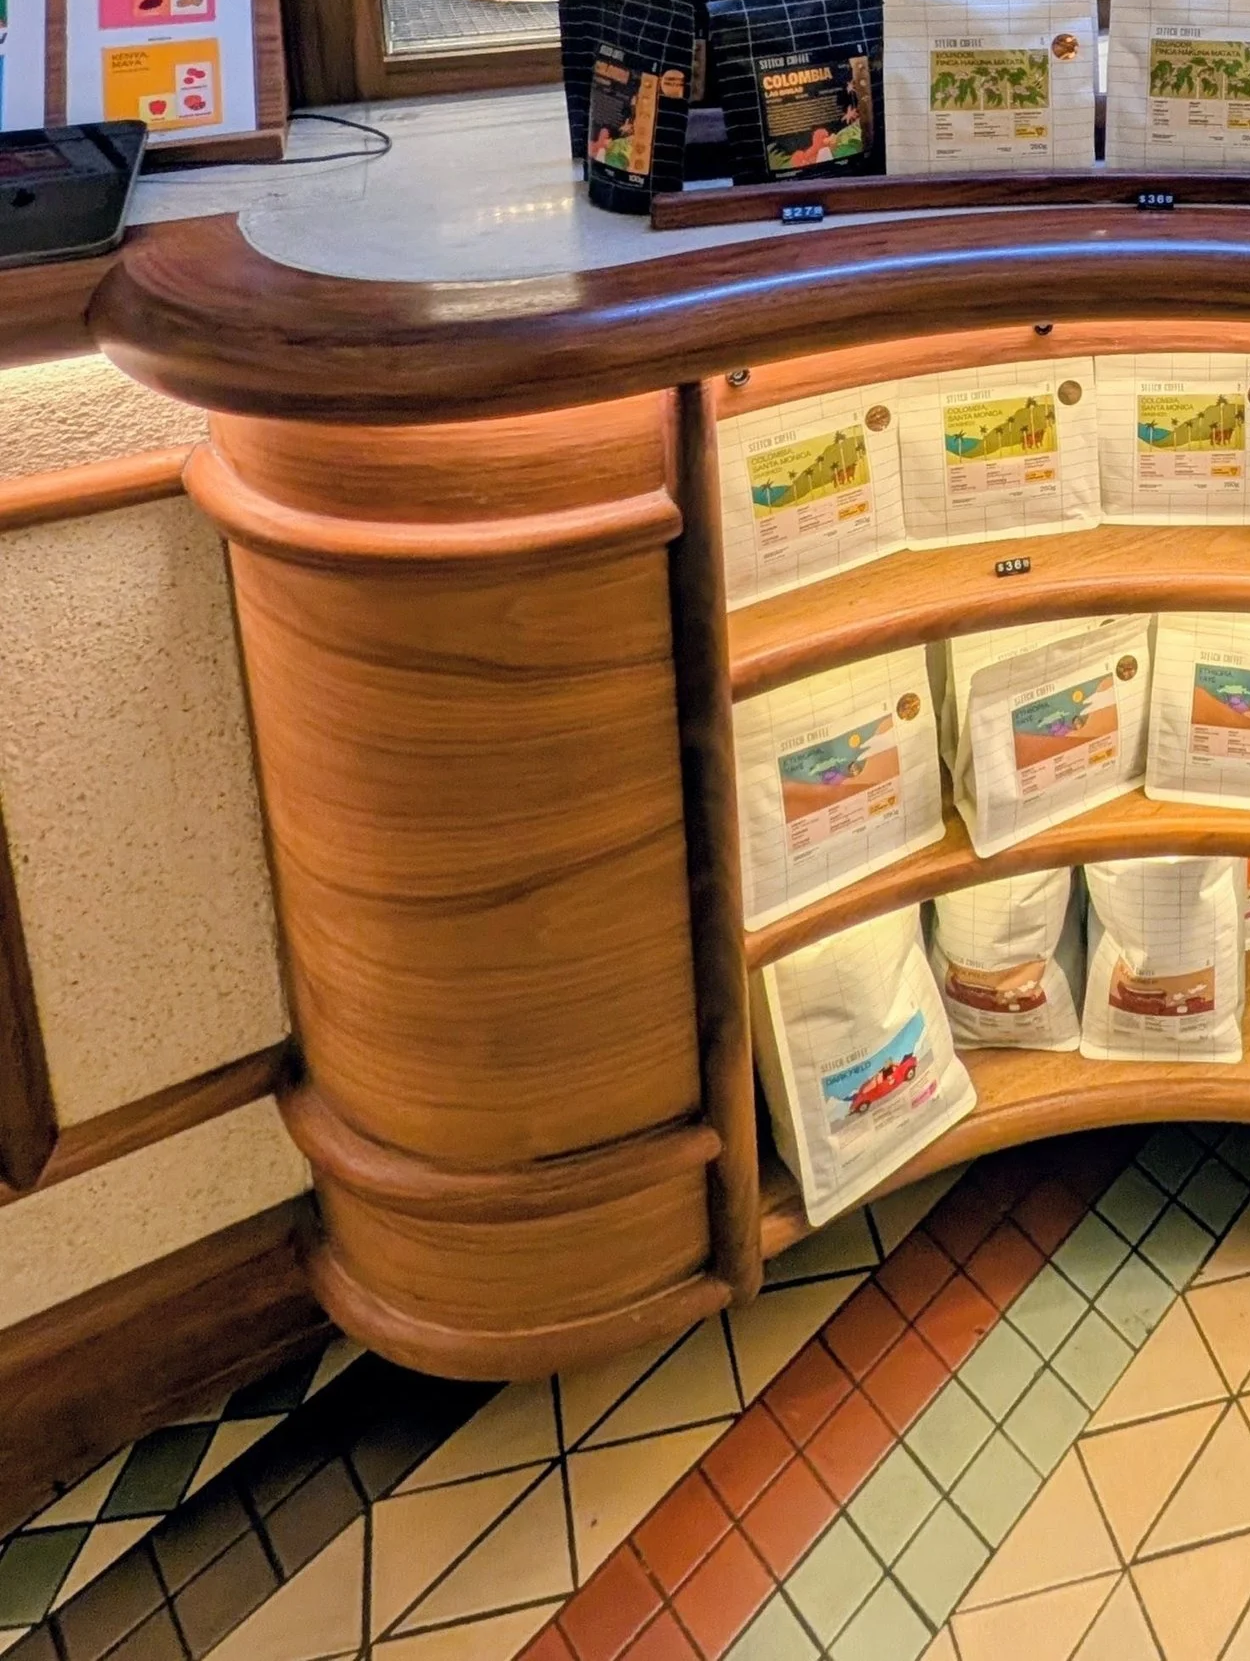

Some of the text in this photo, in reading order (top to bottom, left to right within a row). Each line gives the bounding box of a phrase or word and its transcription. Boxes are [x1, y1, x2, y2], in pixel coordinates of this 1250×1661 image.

[763, 67, 833, 90] COLOMBIA
[946, 390, 991, 404] STITCH COFFEE
[947, 404, 987, 414] COLOMBIA,
[948, 409, 1003, 422] SANTA MONICA
[753, 451, 811, 473] SANTA MONICA
